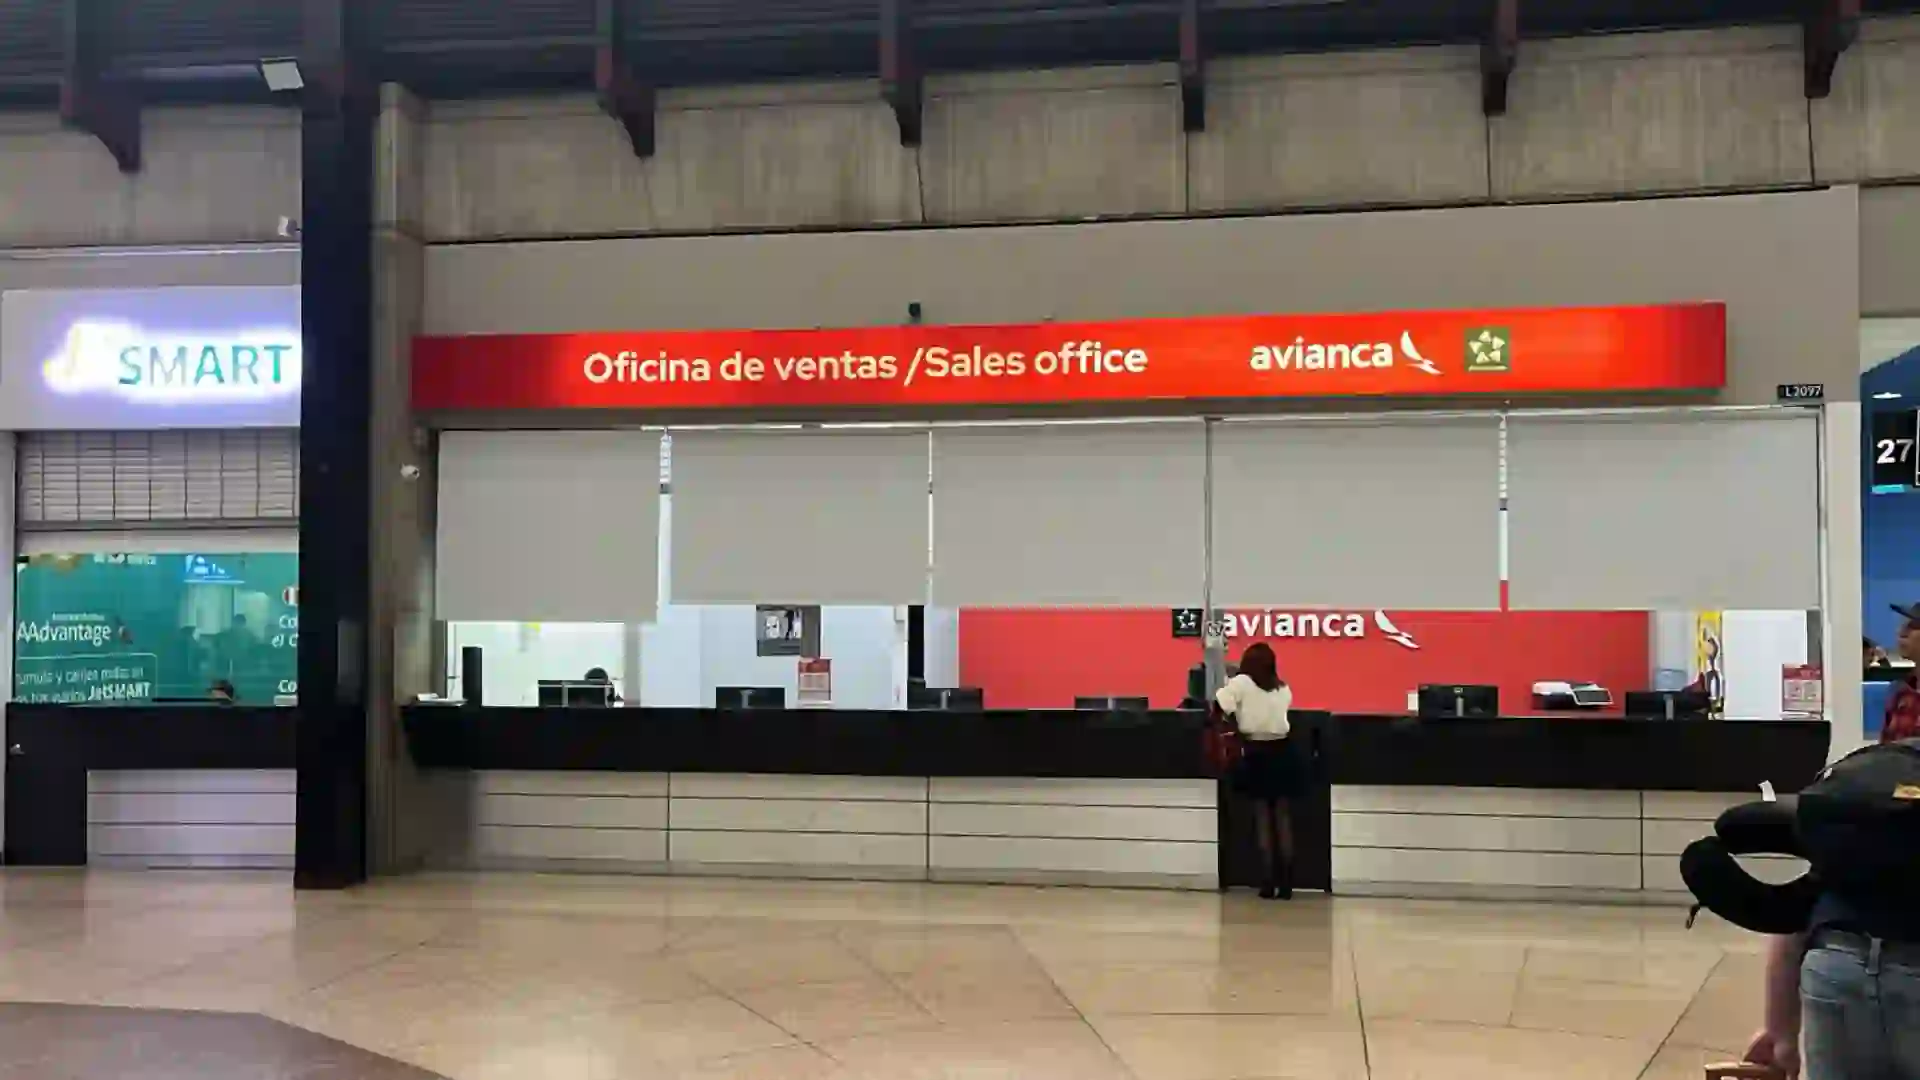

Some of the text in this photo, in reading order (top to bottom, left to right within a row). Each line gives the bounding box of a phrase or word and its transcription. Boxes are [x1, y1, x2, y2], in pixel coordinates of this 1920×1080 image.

[583, 351, 711, 383] Oficina
[719, 350, 765, 382] de
[773, 349, 898, 381] ventas
[1033, 340, 1149, 375] office
[1249, 336, 1393, 370] avianca
[1876, 438, 1913, 464] 27
[17, 620, 112, 647] AAdvantage
[1221, 609, 1365, 638] avianca
